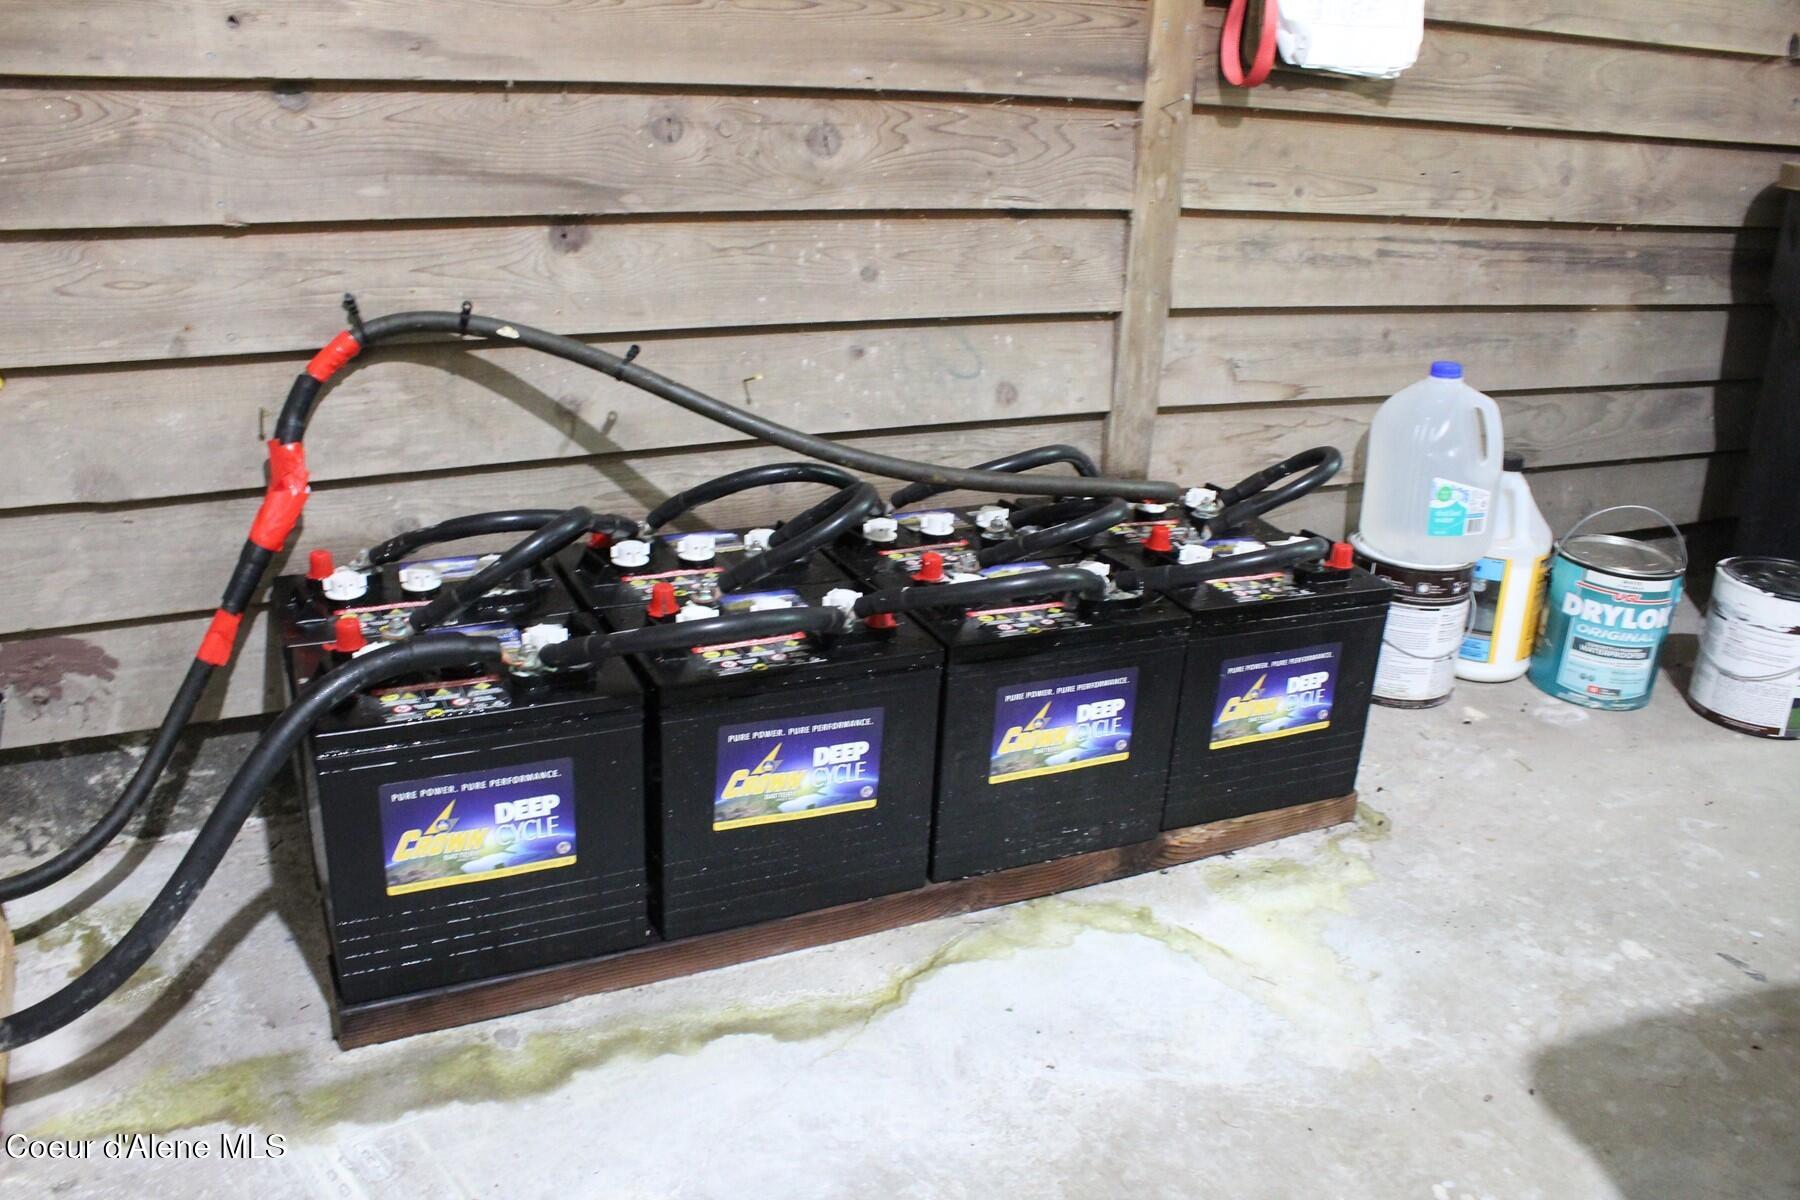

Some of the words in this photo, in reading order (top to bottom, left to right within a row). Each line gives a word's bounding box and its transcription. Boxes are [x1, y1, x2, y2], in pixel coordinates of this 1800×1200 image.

[1286, 671, 1329, 694] DEEP
[1076, 698, 1126, 723] DEEP
[727, 732, 750, 743] PURE
[788, 725, 810, 736] PURE
[812, 741, 870, 767] DEEP
[391, 790, 417, 802] PURE
[420, 785, 458, 798] POWER.
[461, 780, 487, 792] PURE
[489, 769, 562, 788] PERFORMANCE.
[812, 761, 867, 788] CYCLE
[494, 794, 561, 824] DEEP
[495, 815, 560, 846] CYCLE
